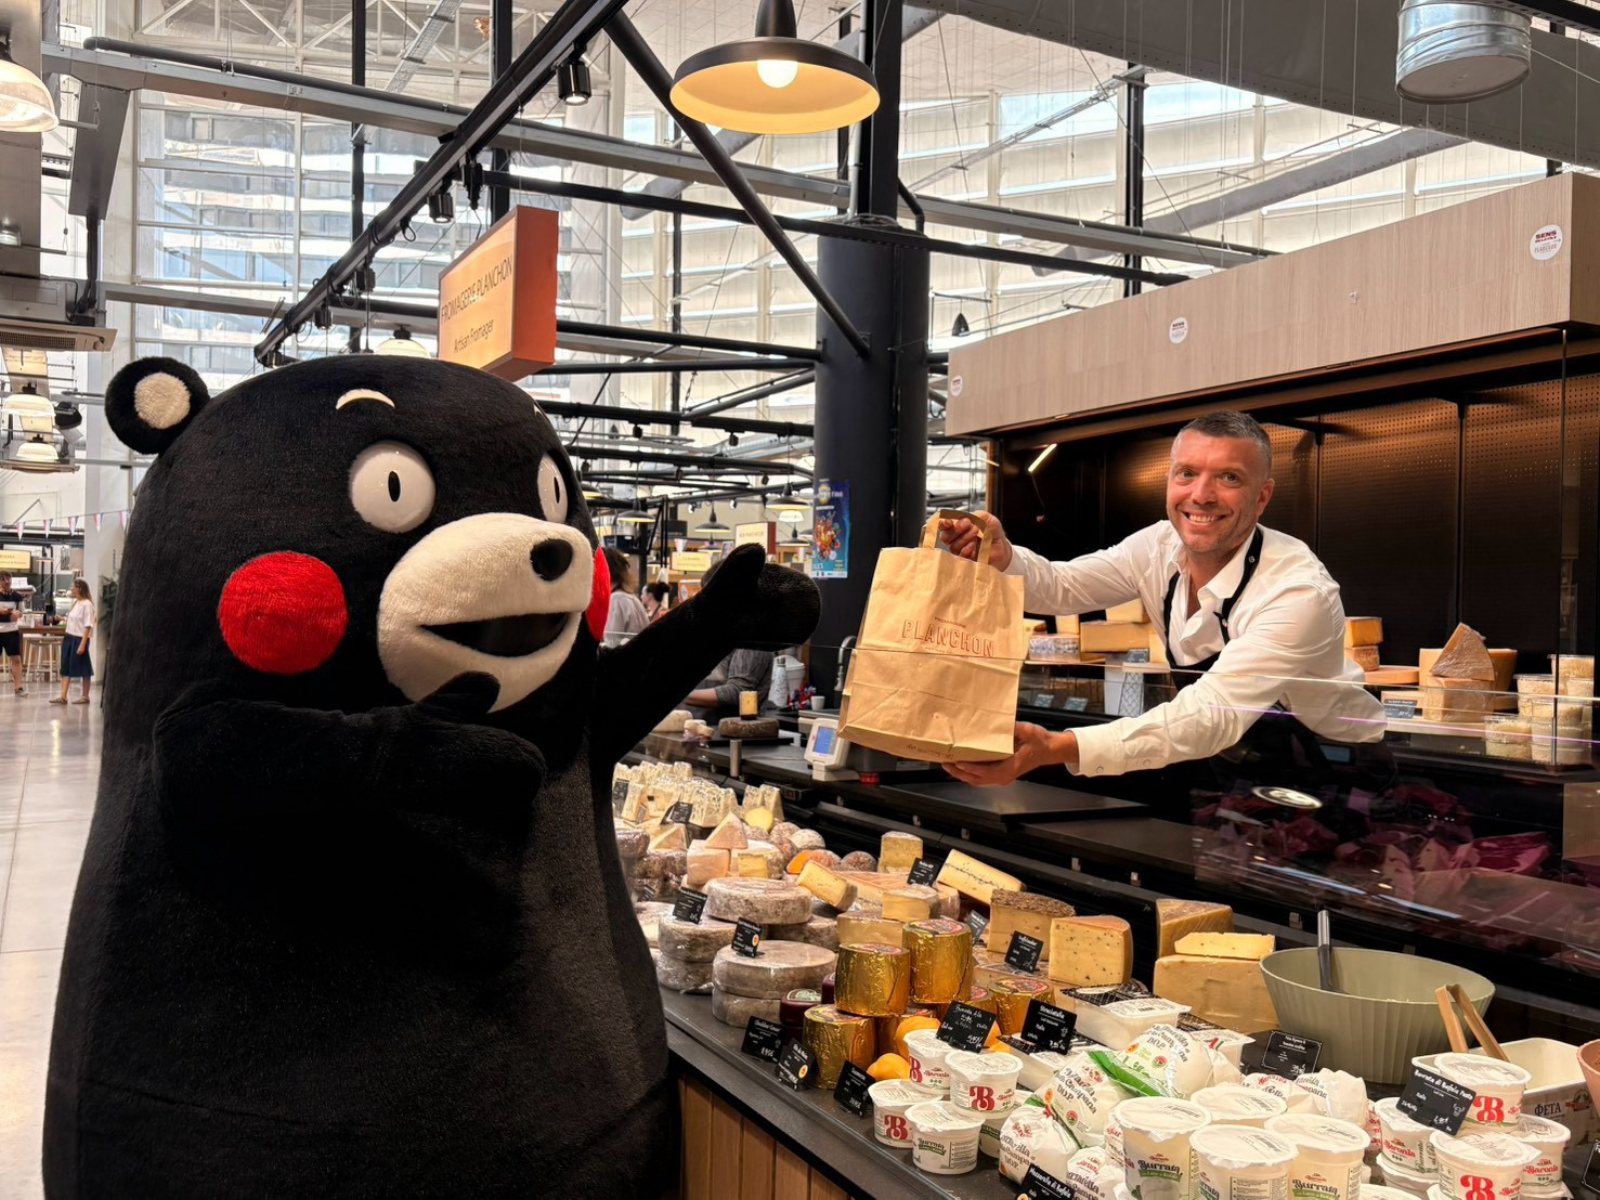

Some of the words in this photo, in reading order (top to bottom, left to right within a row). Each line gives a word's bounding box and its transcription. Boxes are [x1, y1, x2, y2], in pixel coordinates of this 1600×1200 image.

[441, 282, 477, 325] FROMAGERIE
[477, 257, 512, 297] PLANCHON
[454, 334, 470, 353] Artisan
[470, 319, 494, 341] Fromager
[901, 620, 993, 657] PLANCHON
[969, 1086, 995, 1112] B
[1473, 1095, 1504, 1123] B
[884, 1115, 908, 1140] B
[1460, 1174, 1495, 1200] B
